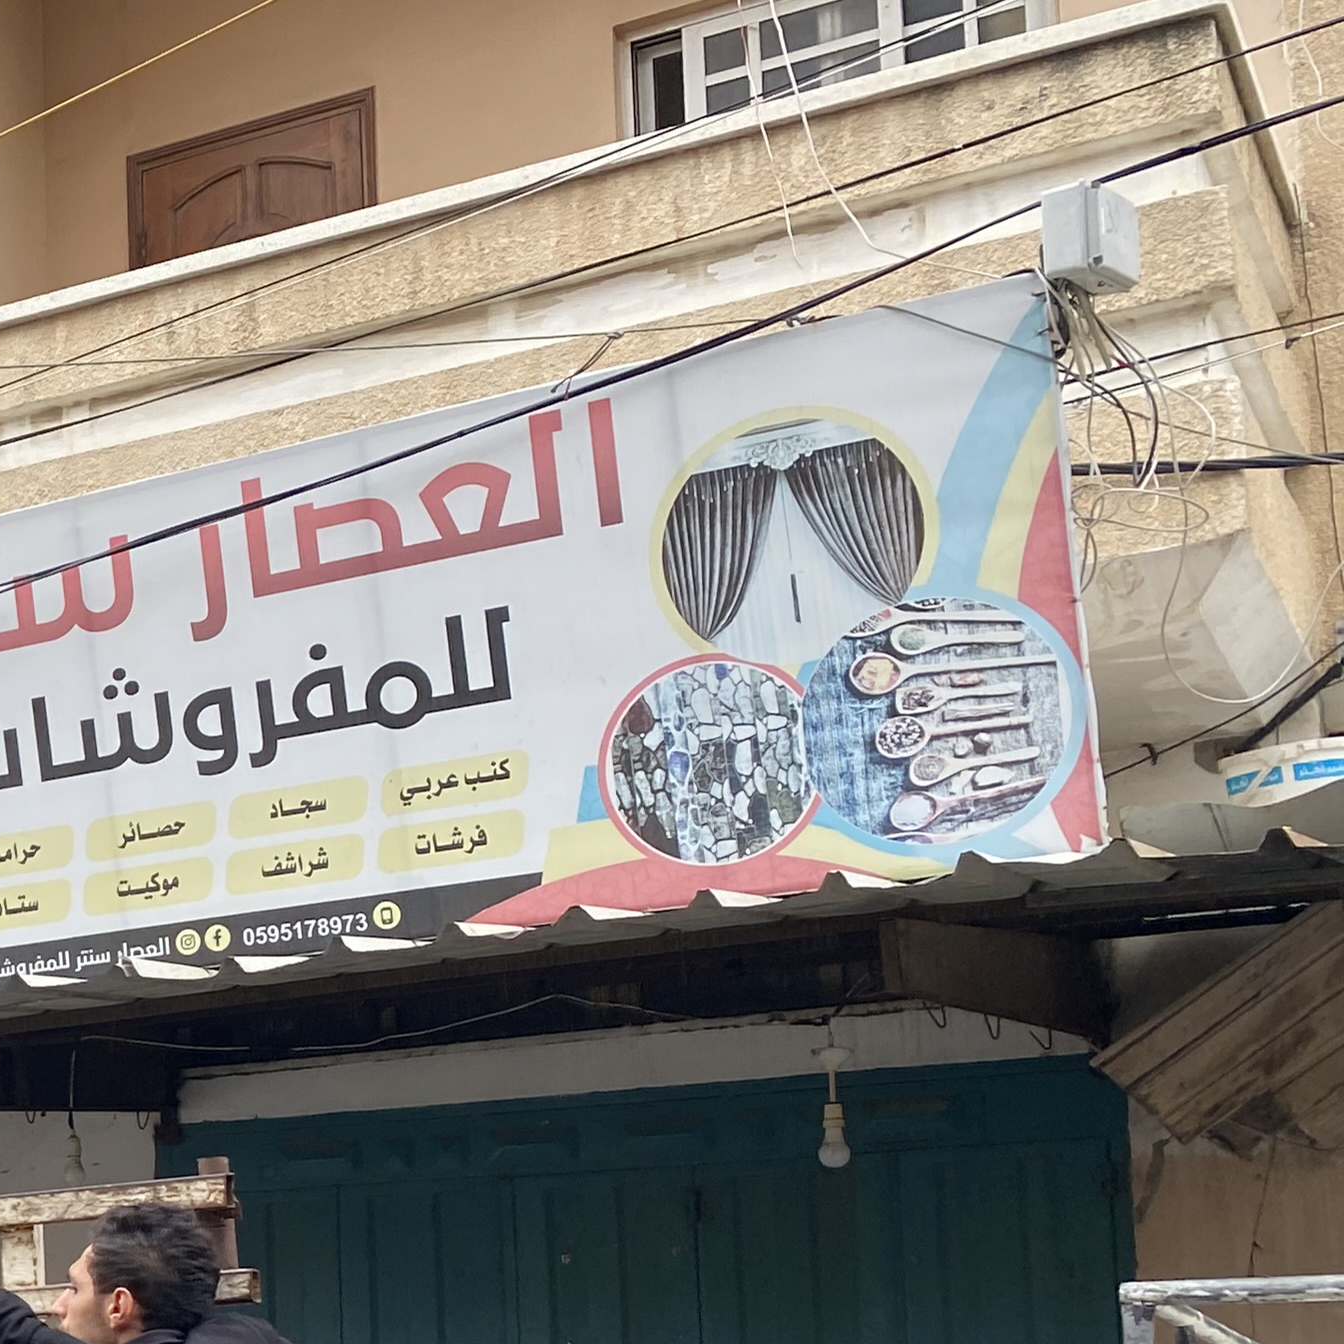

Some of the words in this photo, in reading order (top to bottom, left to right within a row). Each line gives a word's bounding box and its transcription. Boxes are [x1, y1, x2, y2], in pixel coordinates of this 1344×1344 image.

[191, 398, 624, 641] العصار
[399, 773, 459, 807] عربي
[464, 758, 511, 792] كنب
[269, 798, 327, 819] سجاد
[117, 820, 186, 849] حصائر
[414, 825, 488, 855] فرشات
[261, 847, 329, 877] شراشف
[116, 872, 180, 900] موكيت
[242, 913, 369, 947] 0595178973
[75, 947, 111, 973] سنتر
[116, 937, 171, 966] العصار
